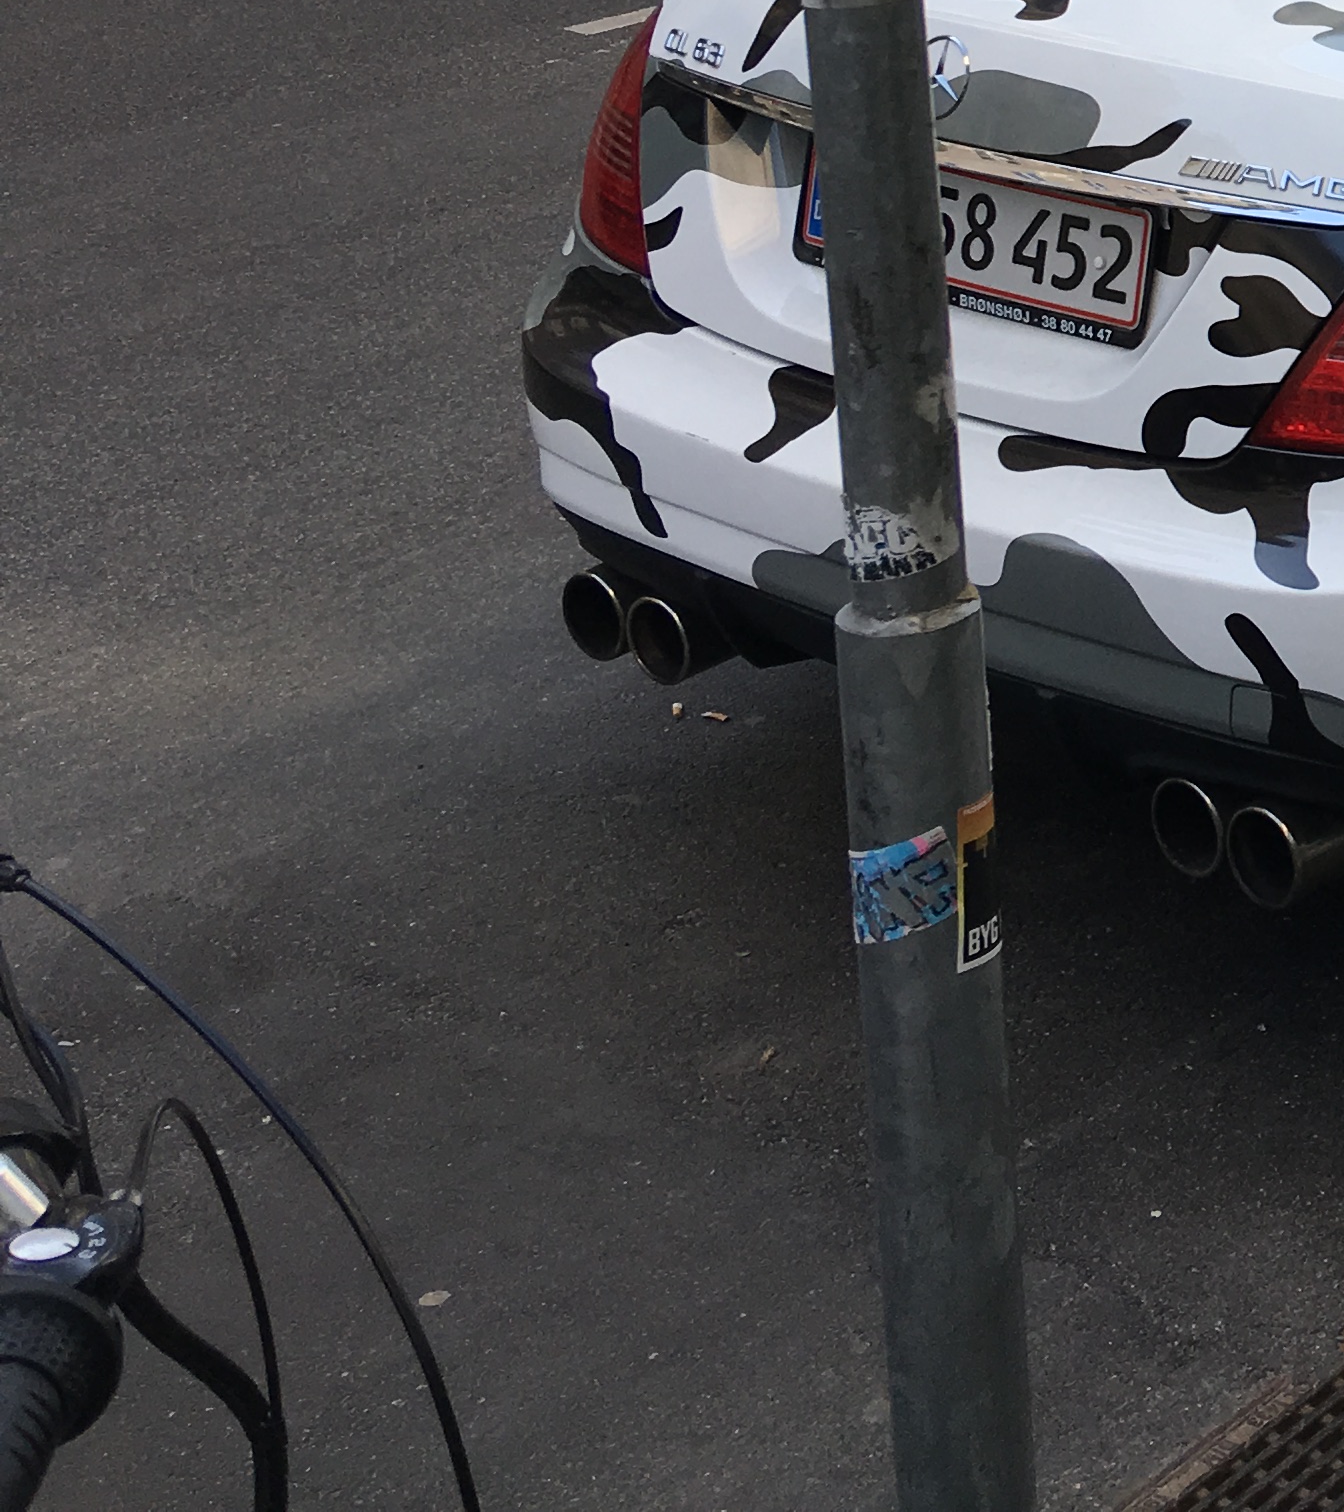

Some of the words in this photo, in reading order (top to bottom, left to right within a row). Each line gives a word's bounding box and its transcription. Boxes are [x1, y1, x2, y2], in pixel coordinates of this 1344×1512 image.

[1011, 208, 1133, 305] 452
[959, 293, 1030, 323] BRØNSHØJ
[1041, 314, 1057, 330] 38
[1060, 319, 1076, 335] 80
[1078, 324, 1094, 339] 44
[1096, 328, 1112, 342] 47
